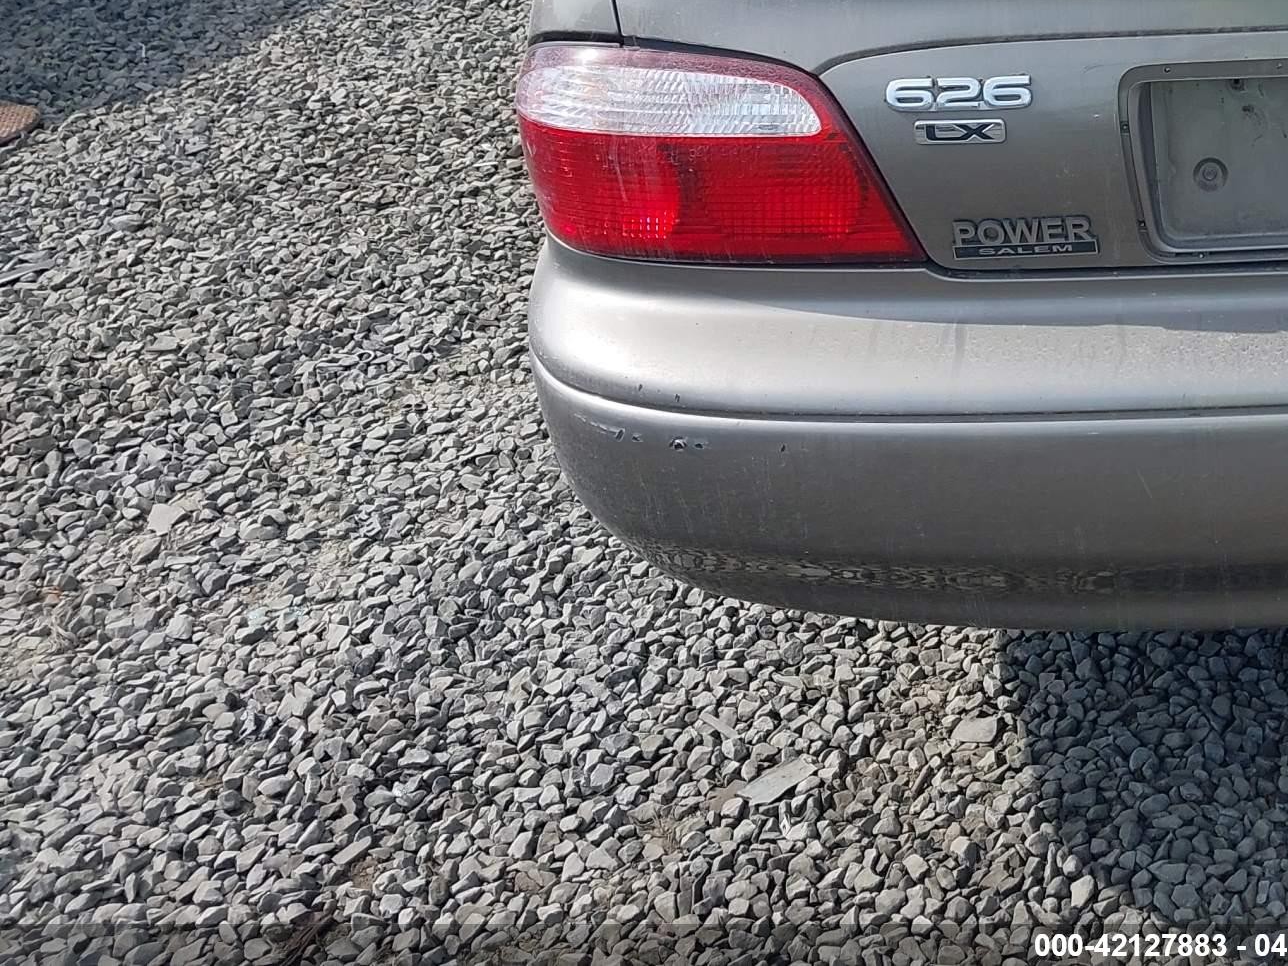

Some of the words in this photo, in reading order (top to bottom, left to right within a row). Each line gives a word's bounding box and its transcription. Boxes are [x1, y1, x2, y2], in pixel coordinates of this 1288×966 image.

[886, 75, 1032, 111] 626
[925, 123, 995, 142] LX
[952, 216, 1093, 247] POWER
[978, 242, 1073, 256] SALEM
